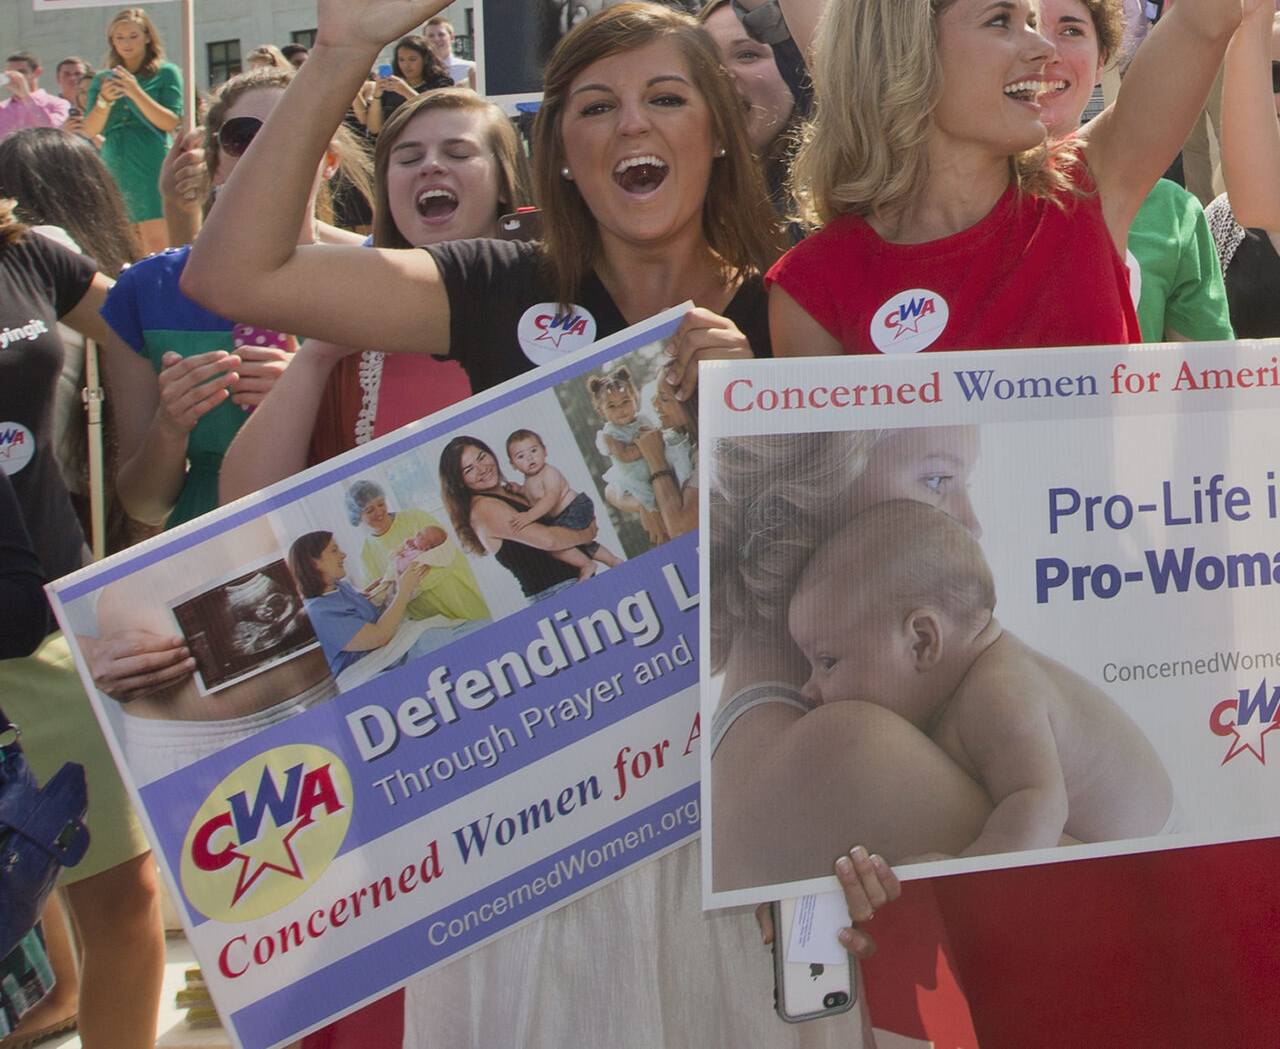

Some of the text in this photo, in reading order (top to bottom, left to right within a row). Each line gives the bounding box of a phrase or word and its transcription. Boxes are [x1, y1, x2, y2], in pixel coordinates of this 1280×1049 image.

[534, 313, 589, 336] CWA
[884, 296, 936, 329] CWA
[724, 371, 942, 414] Concerned
[954, 368, 1098, 403] Women
[1110, 363, 1161, 397] for
[0, 428, 25, 446] WA
[1048, 474, 1250, 534] Pro-Life
[345, 590, 663, 766] Defending
[372, 724, 517, 808] Through
[520, 670, 625, 743] Prayer
[633, 635, 695, 685] and
[191, 762, 345, 873] CWA
[219, 738, 670, 980] Concerned Women for
[427, 799, 700, 947] ConcernedWomen.org
